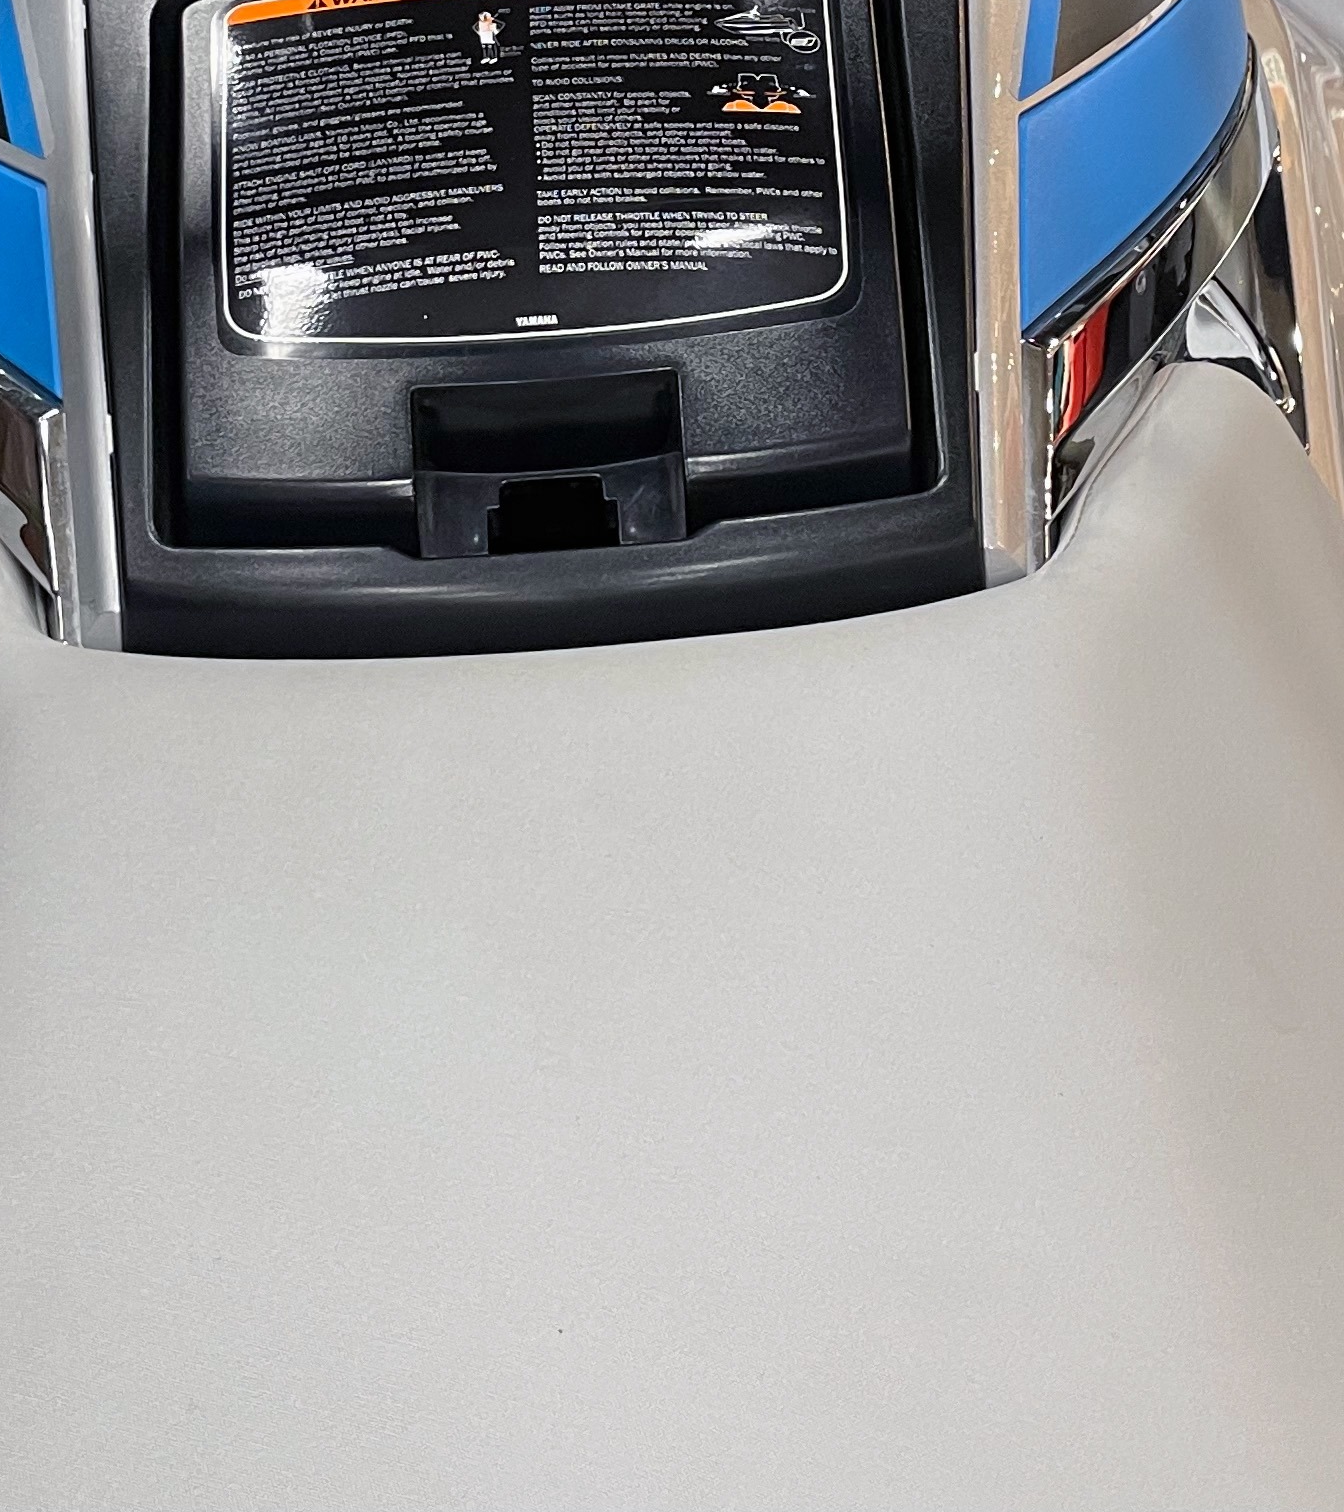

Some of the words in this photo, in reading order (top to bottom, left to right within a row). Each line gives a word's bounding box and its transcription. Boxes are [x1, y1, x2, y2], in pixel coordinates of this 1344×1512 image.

[533, 94, 555, 102] SCAN
[558, 92, 611, 100] CONSTANTLY
[392, 190, 446, 201] AGGRESSIVE
[448, 184, 503, 195] MANEUVERS
[537, 190, 558, 198] TAKE
[561, 189, 587, 197] EARLY
[538, 216, 551, 224] DO
[574, 213, 613, 221] RELEASE
[616, 212, 660, 220] THROTTLE
[692, 212, 724, 220] TRYING
[726, 212, 737, 220] TO
[569, 250, 586, 258] See
[661, 248, 673, 256] for
[376, 259, 411, 271] ANYONE
[413, 258, 422, 266] IS
[437, 254, 460, 263] REAR
[463, 252, 475, 261] OF
[539, 264, 564, 272] READ
[566, 263, 586, 271] AND
[588, 262, 624, 270] FOLLOW
[626, 261, 668, 269] OWNER'S
[449, 273, 478, 282] severe
[516, 314, 558, 327] YAMAHA
